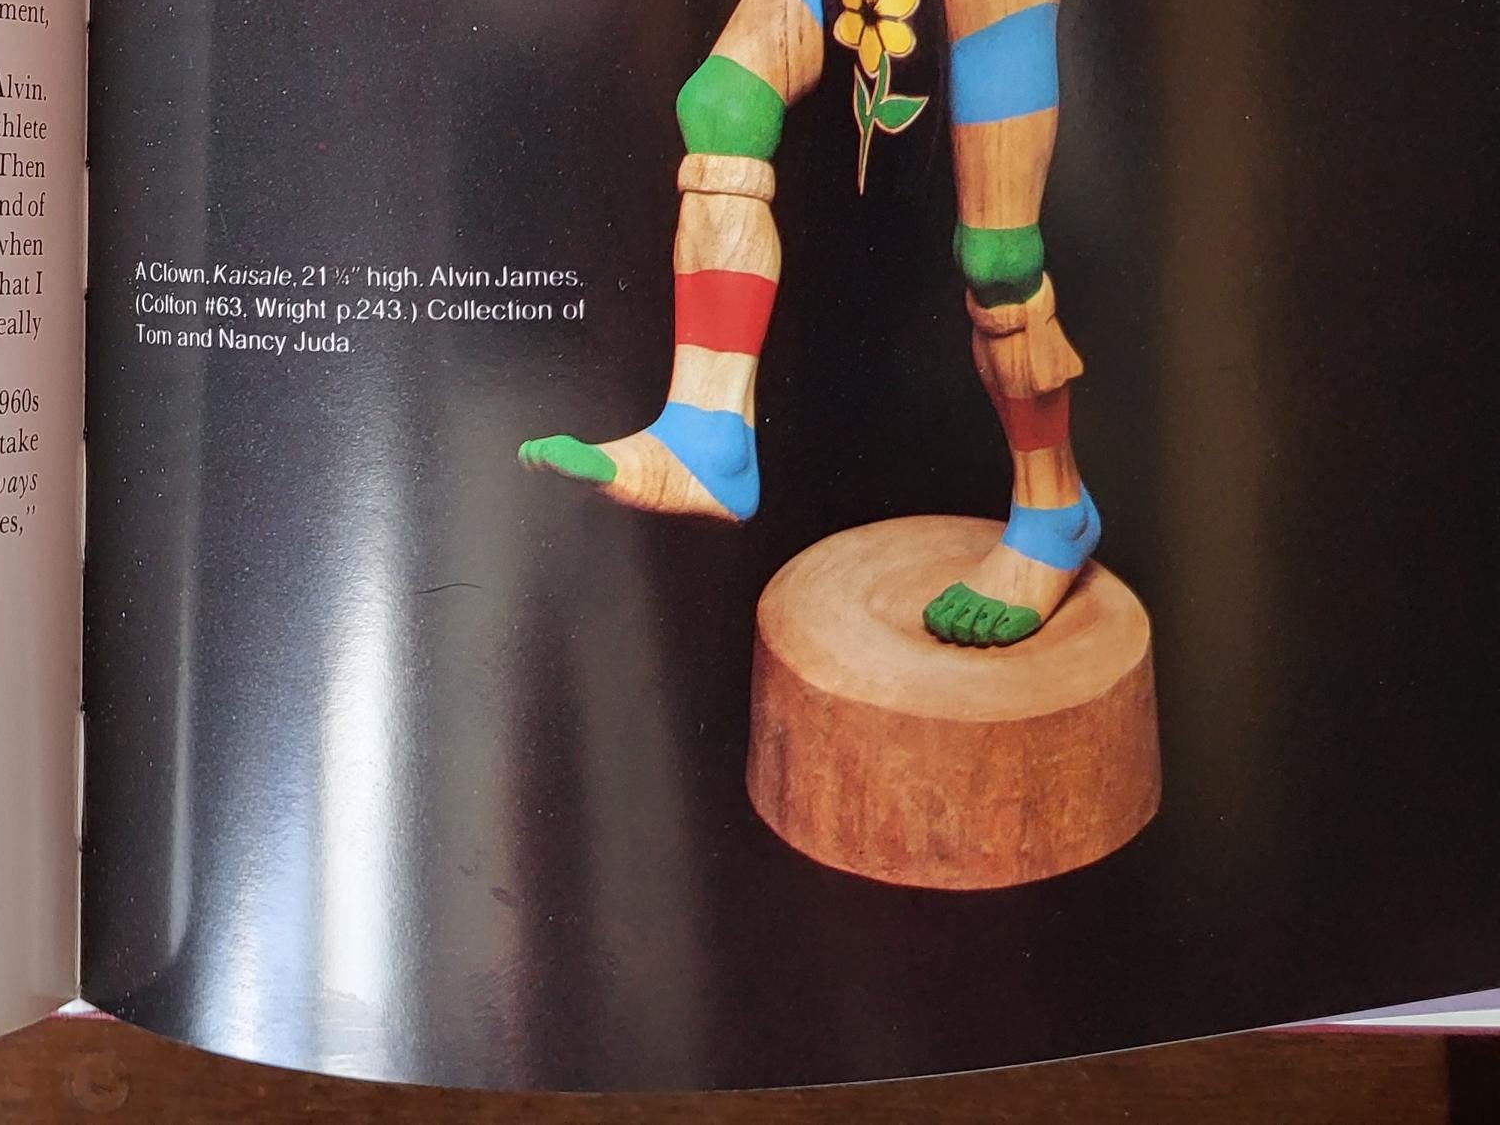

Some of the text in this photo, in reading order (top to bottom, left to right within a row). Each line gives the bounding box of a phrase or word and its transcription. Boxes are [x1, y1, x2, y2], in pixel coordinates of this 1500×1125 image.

[35, 270, 45, 295] I
[134, 261, 148, 282] A
[429, 264, 491, 287] Alvin
[134, 292, 198, 316] (Colton
[254, 296, 328, 324] Wright
[336, 297, 418, 324] p.243.)
[426, 297, 553, 321] Collection
[562, 297, 586, 321] of
[134, 323, 357, 356] Tom and Nancy Juda.
[0, 427, 41, 455] take
